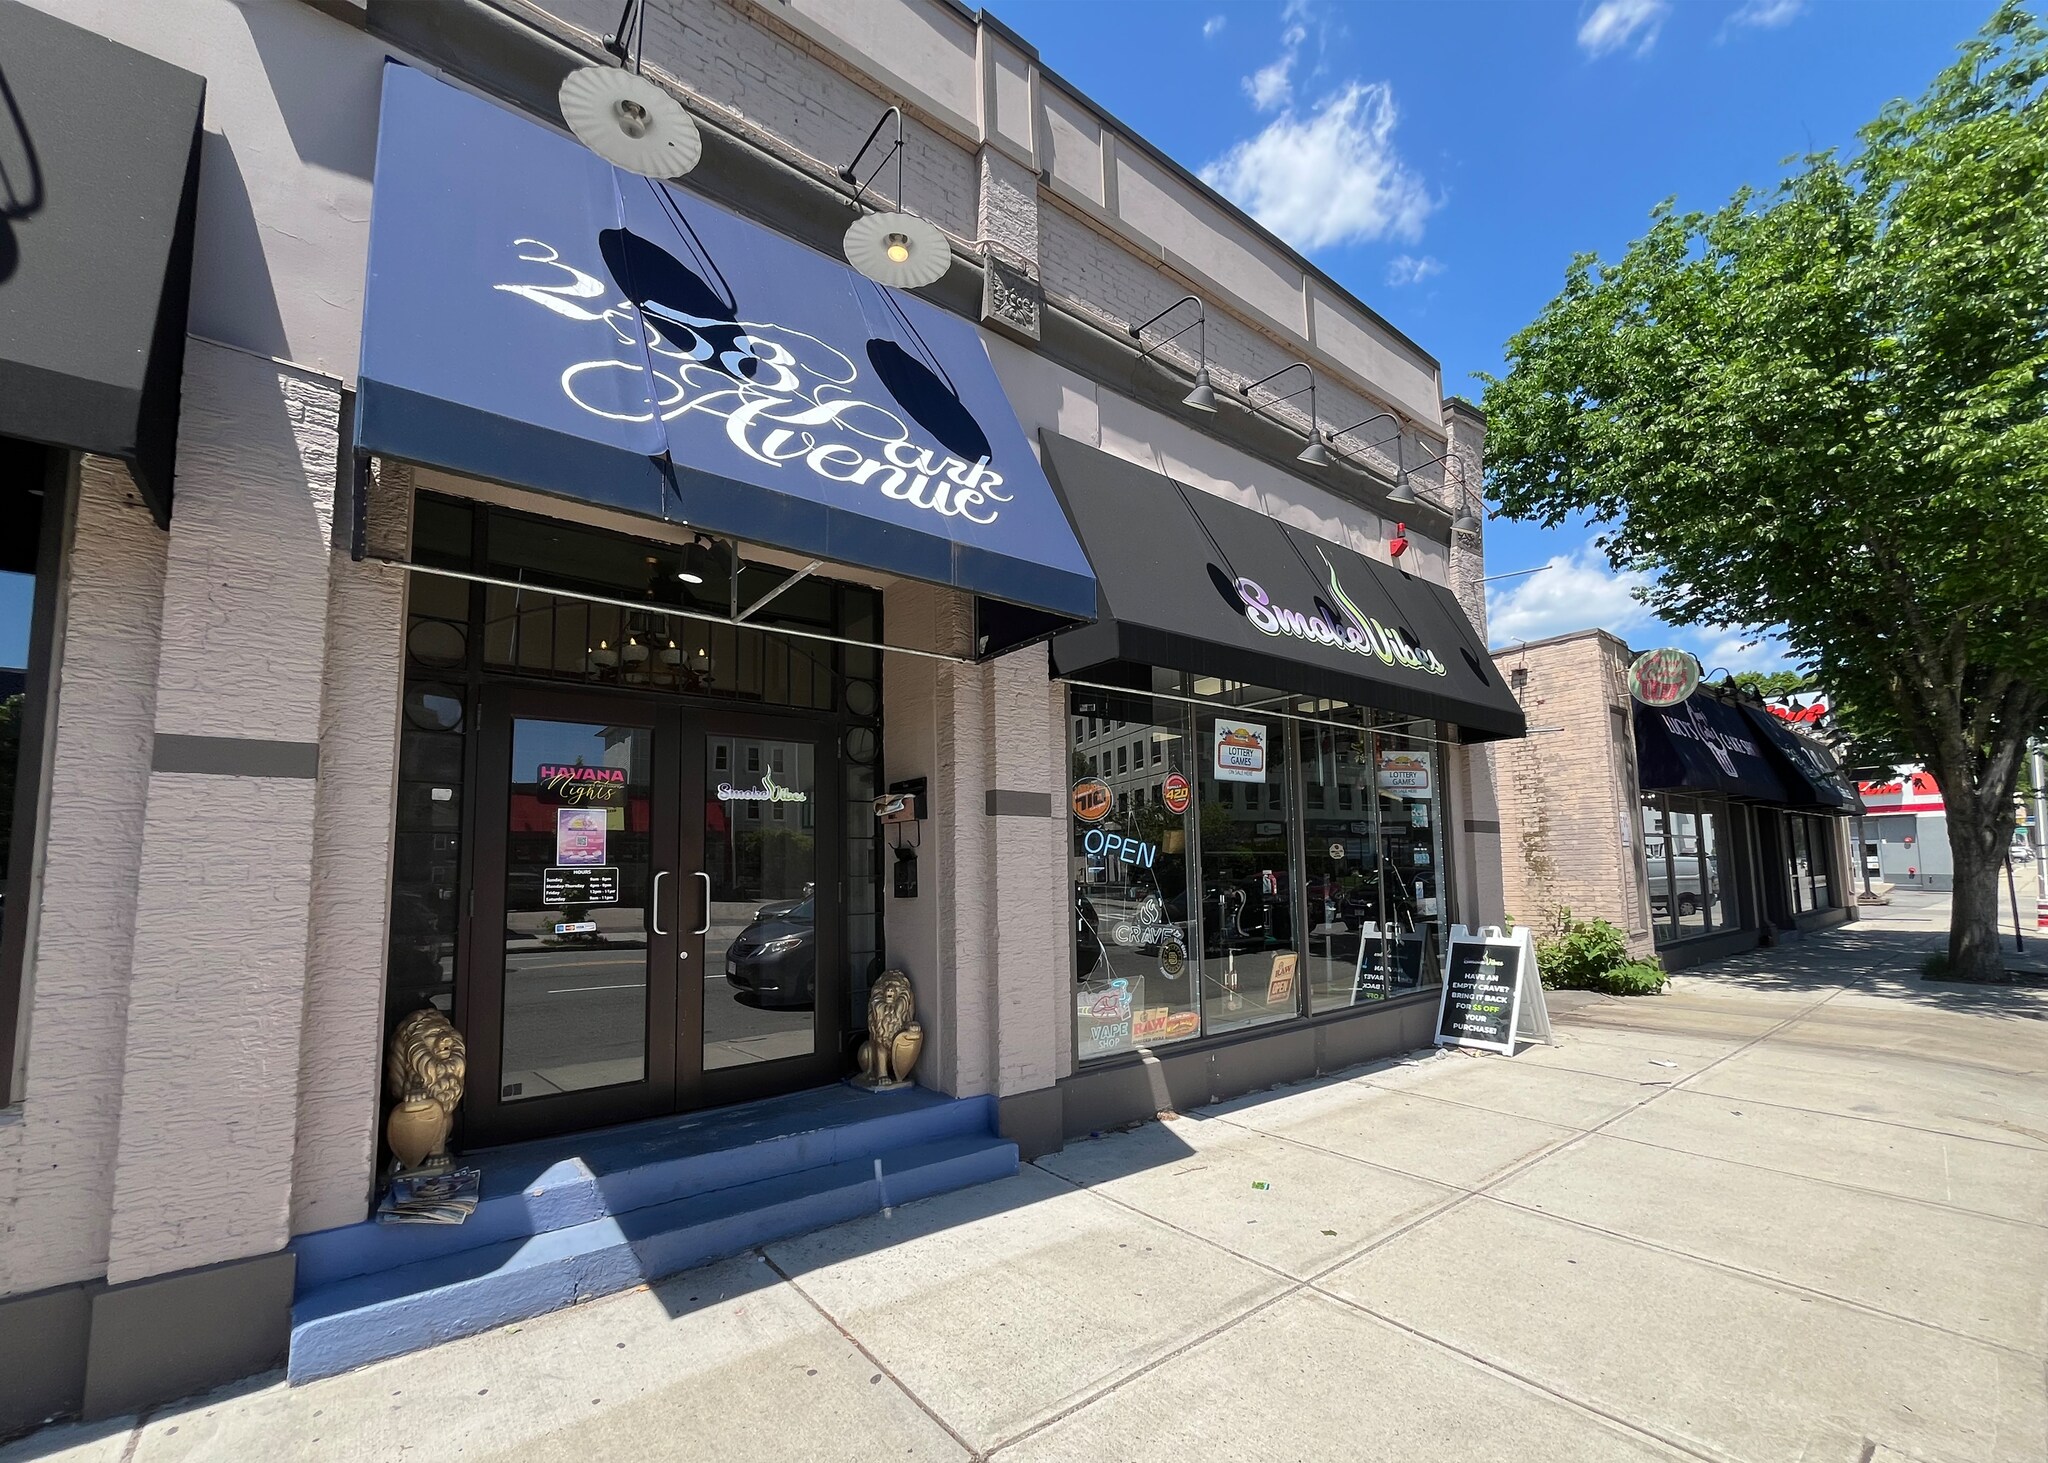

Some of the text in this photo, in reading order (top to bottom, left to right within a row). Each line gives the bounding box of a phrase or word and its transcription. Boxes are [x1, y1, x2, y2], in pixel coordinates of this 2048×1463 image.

[493, 238, 857, 392] 258
[1232, 577, 1373, 657] Smoke
[1228, 747, 1254, 757] LOTTERY
[1230, 757, 1252, 766] GAMES
[541, 766, 624, 782] HAVANA
[540, 773, 616, 805] Nights
[717, 778, 806, 802] Smoke Vibes
[1165, 787, 1189, 800] 420
[1084, 829, 1156, 868] OPEN
[1486, 974, 1499, 982] AN
[1452, 981, 1510, 993] EMPTY CRAVE?
[1451, 991, 1475, 1000] BRING
[1484, 994, 1508, 1004] BACK
[1455, 1002, 1471, 1010] FOR
[1482, 1005, 1500, 1013] OFF
[1465, 1013, 1487, 1022] YOUR
[1090, 1022, 1129, 1041] VAPE
[1133, 1016, 1167, 1036] RAW
[1452, 1022, 1498, 1035] PURCHASE!
[1098, 1037, 1120, 1049] SHOP
